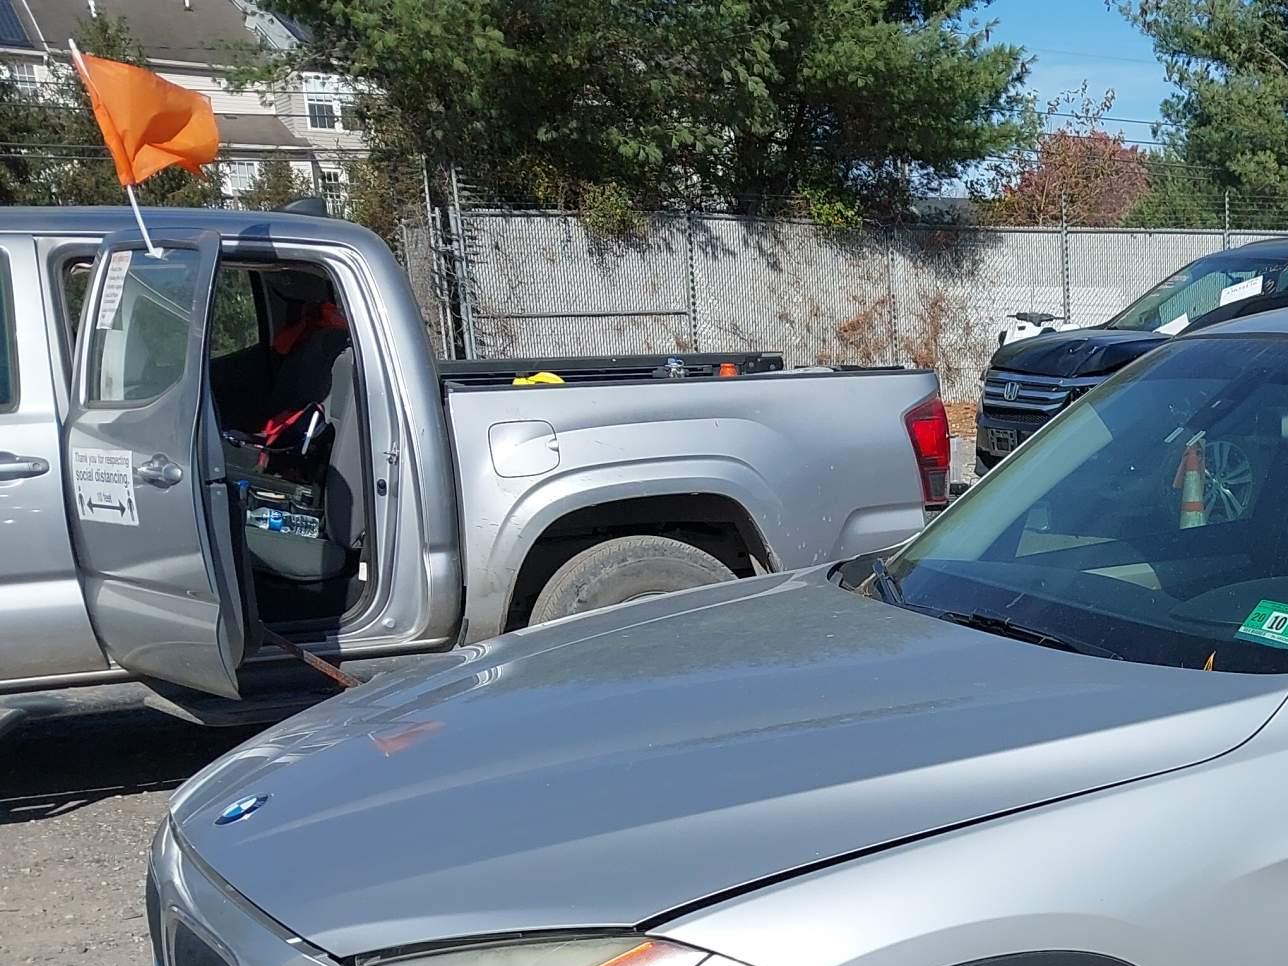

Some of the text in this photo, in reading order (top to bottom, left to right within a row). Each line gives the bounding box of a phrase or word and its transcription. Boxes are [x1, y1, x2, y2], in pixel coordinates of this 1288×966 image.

[75, 452, 88, 464] Thank
[88, 455, 97, 465] you
[105, 455, 129, 468] respecting
[75, 467, 94, 481] social
[1251, 612, 1267, 623] 20
[1266, 615, 1288, 631] 10
